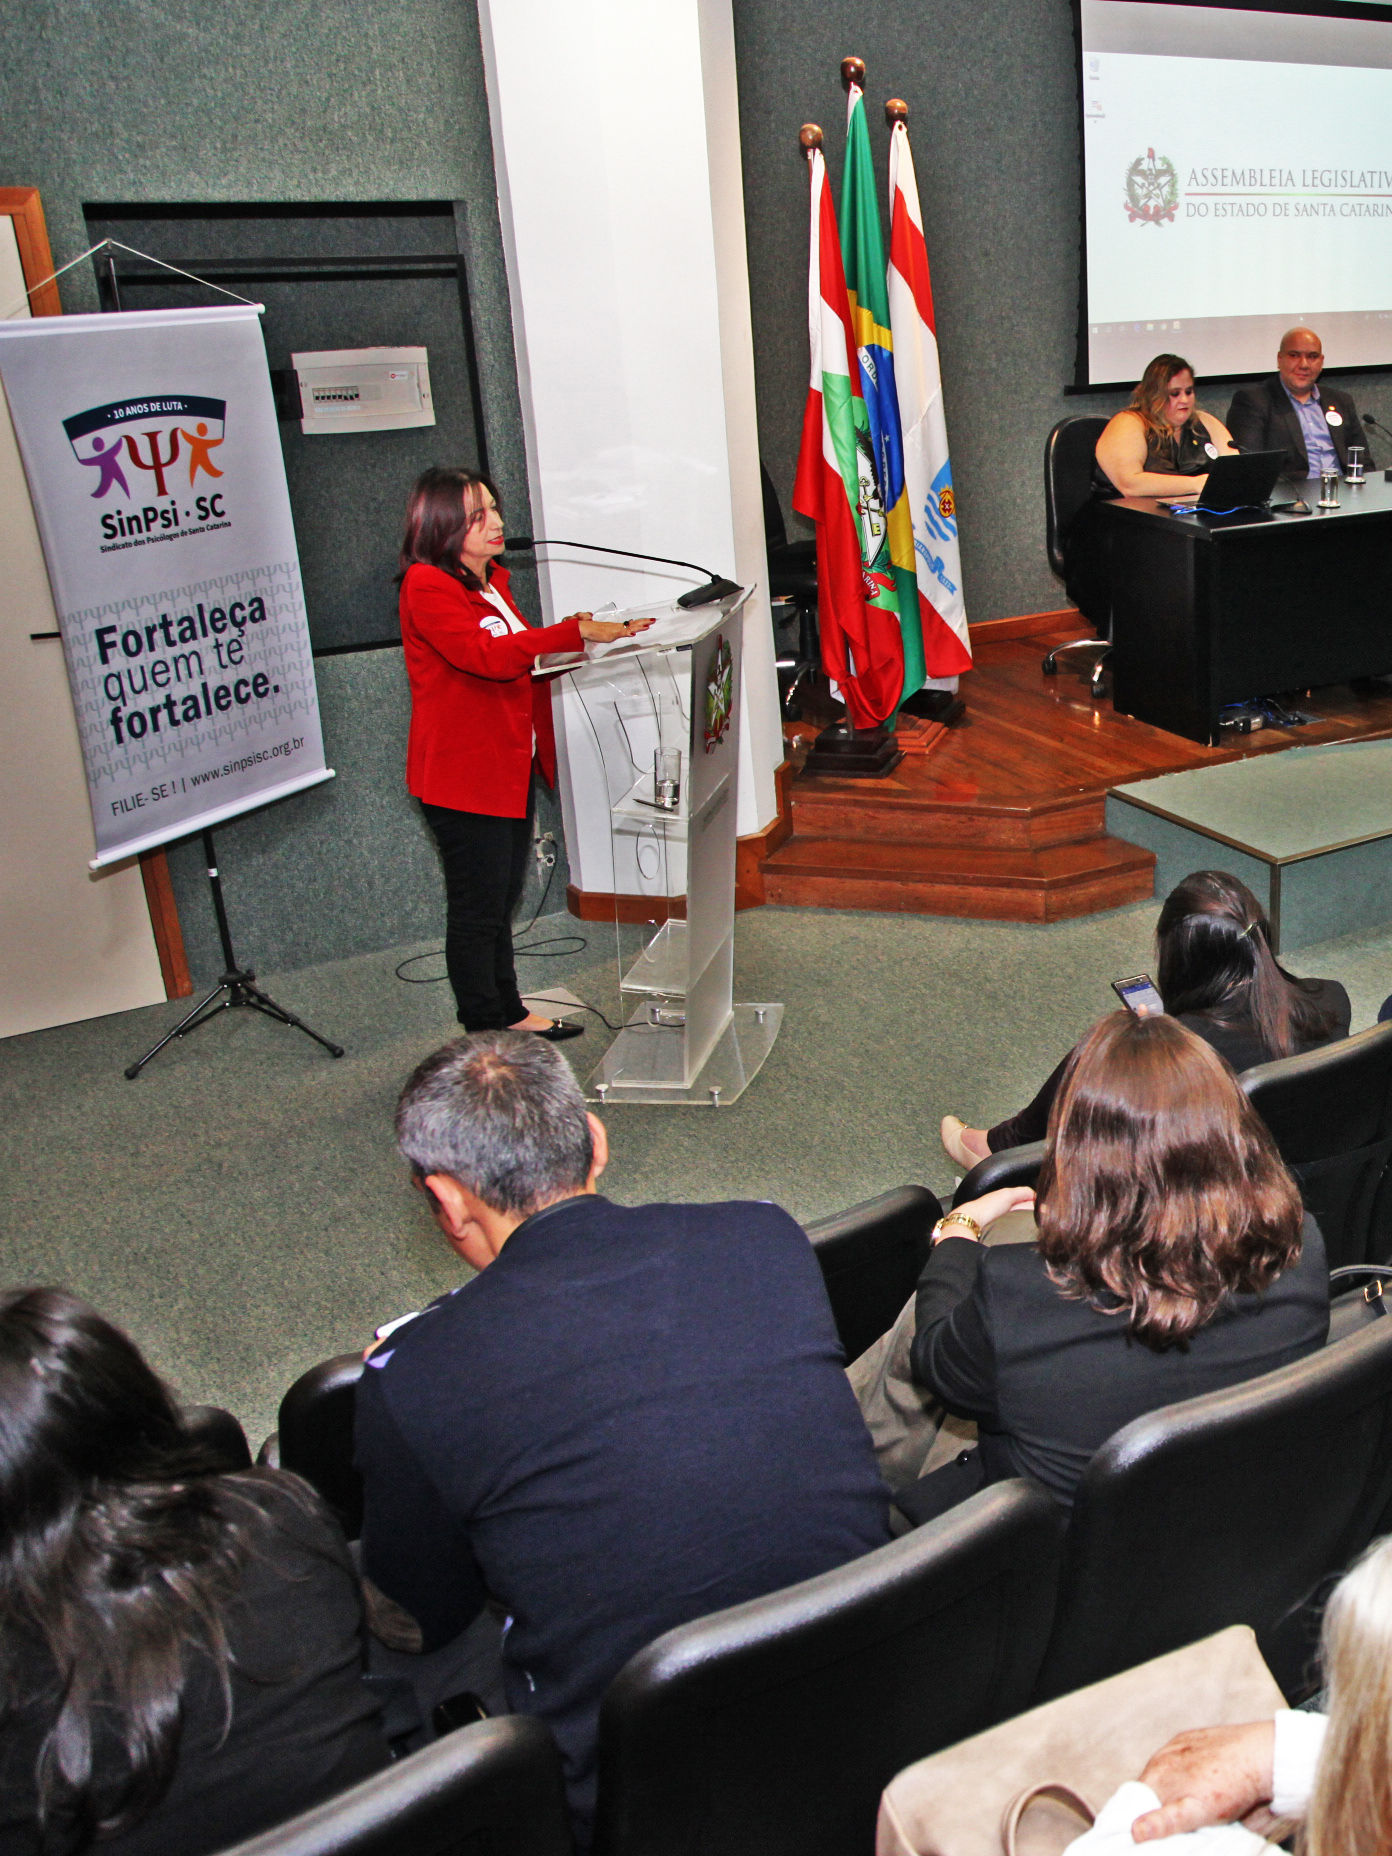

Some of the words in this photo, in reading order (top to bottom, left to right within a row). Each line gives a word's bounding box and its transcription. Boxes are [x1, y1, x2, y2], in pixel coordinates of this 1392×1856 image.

[1187, 167, 1296, 187] ASSEMBLEIA
[1186, 202, 1209, 217] DO
[1214, 202, 1267, 217] ESTADO
[1272, 202, 1290, 217] DE
[1294, 202, 1336, 217] SANTA
[113, 409, 124, 419] 10
[125, 403, 149, 416] ANOS
[150, 402, 161, 412] DE
[162, 401, 183, 411] LUTA
[100, 539, 132, 553] Sindicato
[133, 538, 146, 548] dos
[180, 529, 188, 537] de
[188, 526, 206, 536] Santa
[206, 520, 232, 532] Catarina
[95, 596, 267, 665] Fortaleça
[104, 650, 204, 707] quem
[213, 638, 245, 669] te
[110, 673, 280, 744] fortalece.
[190, 735, 305, 787] www.sinpsisc.org.br
